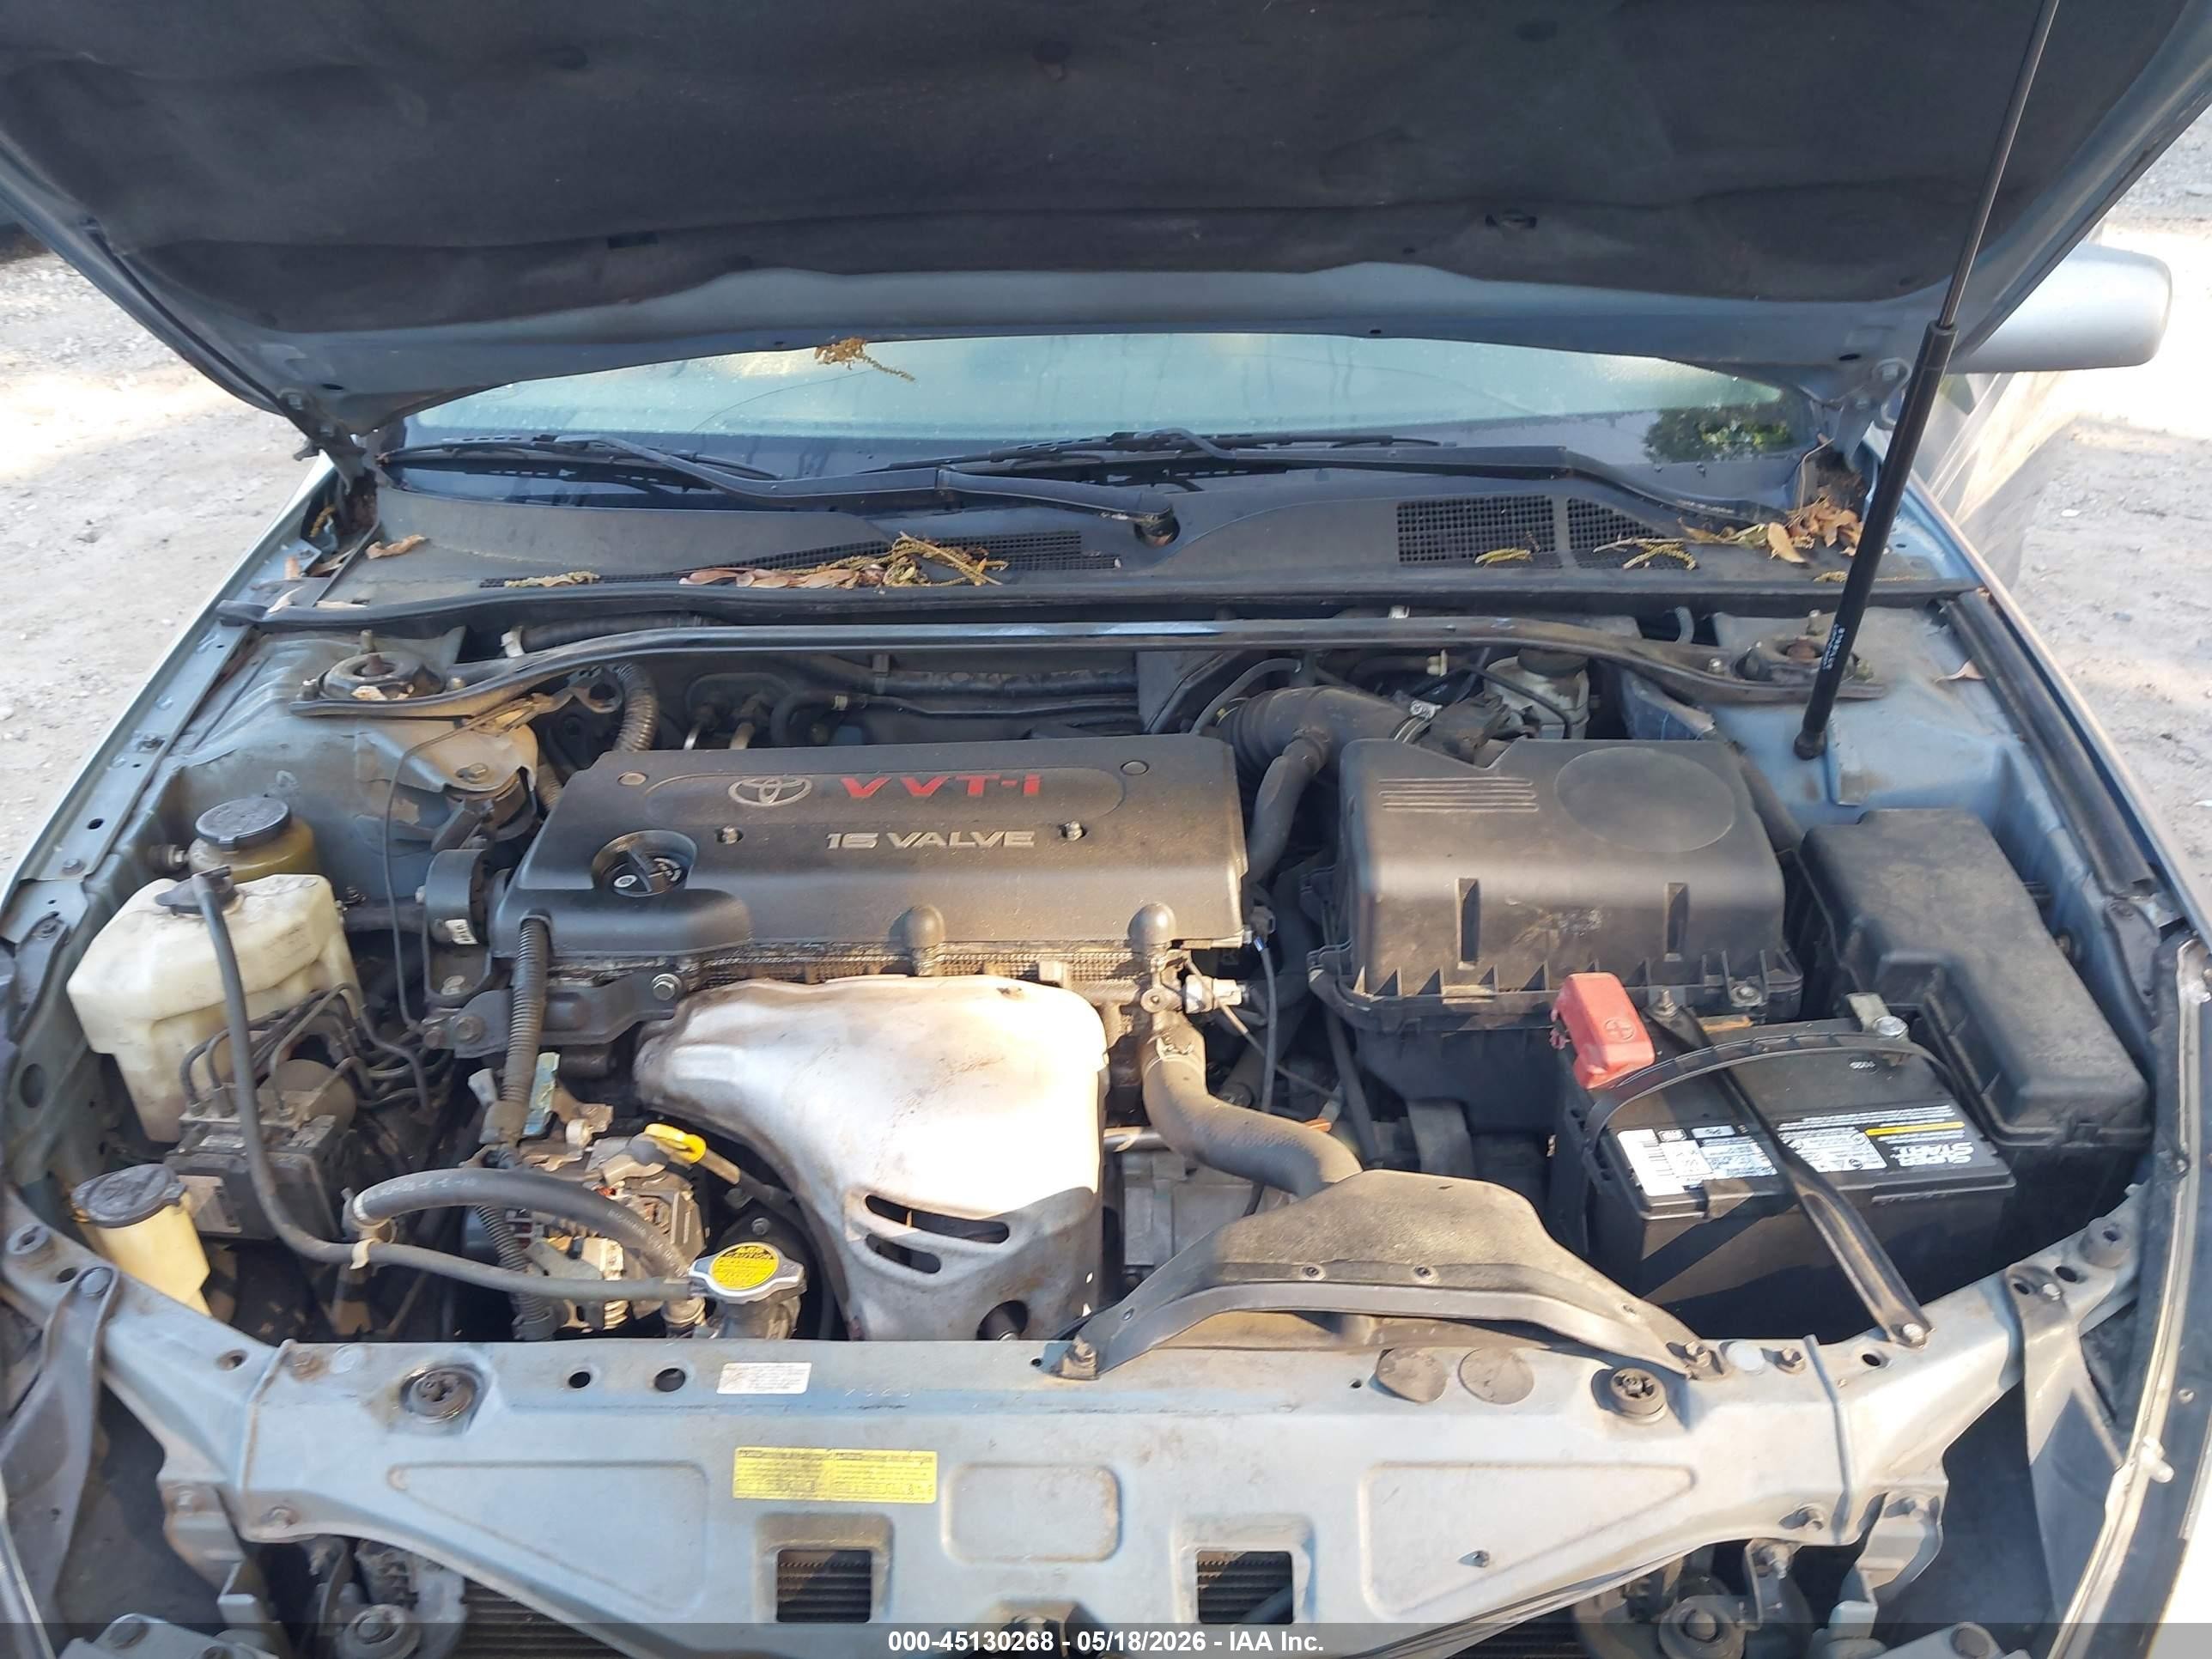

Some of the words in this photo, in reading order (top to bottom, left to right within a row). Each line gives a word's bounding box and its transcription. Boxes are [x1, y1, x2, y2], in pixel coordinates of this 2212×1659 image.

[842, 774, 1042, 798] VVT-i
[825, 832, 879, 849] 16
[886, 830, 1036, 849] VALVE
